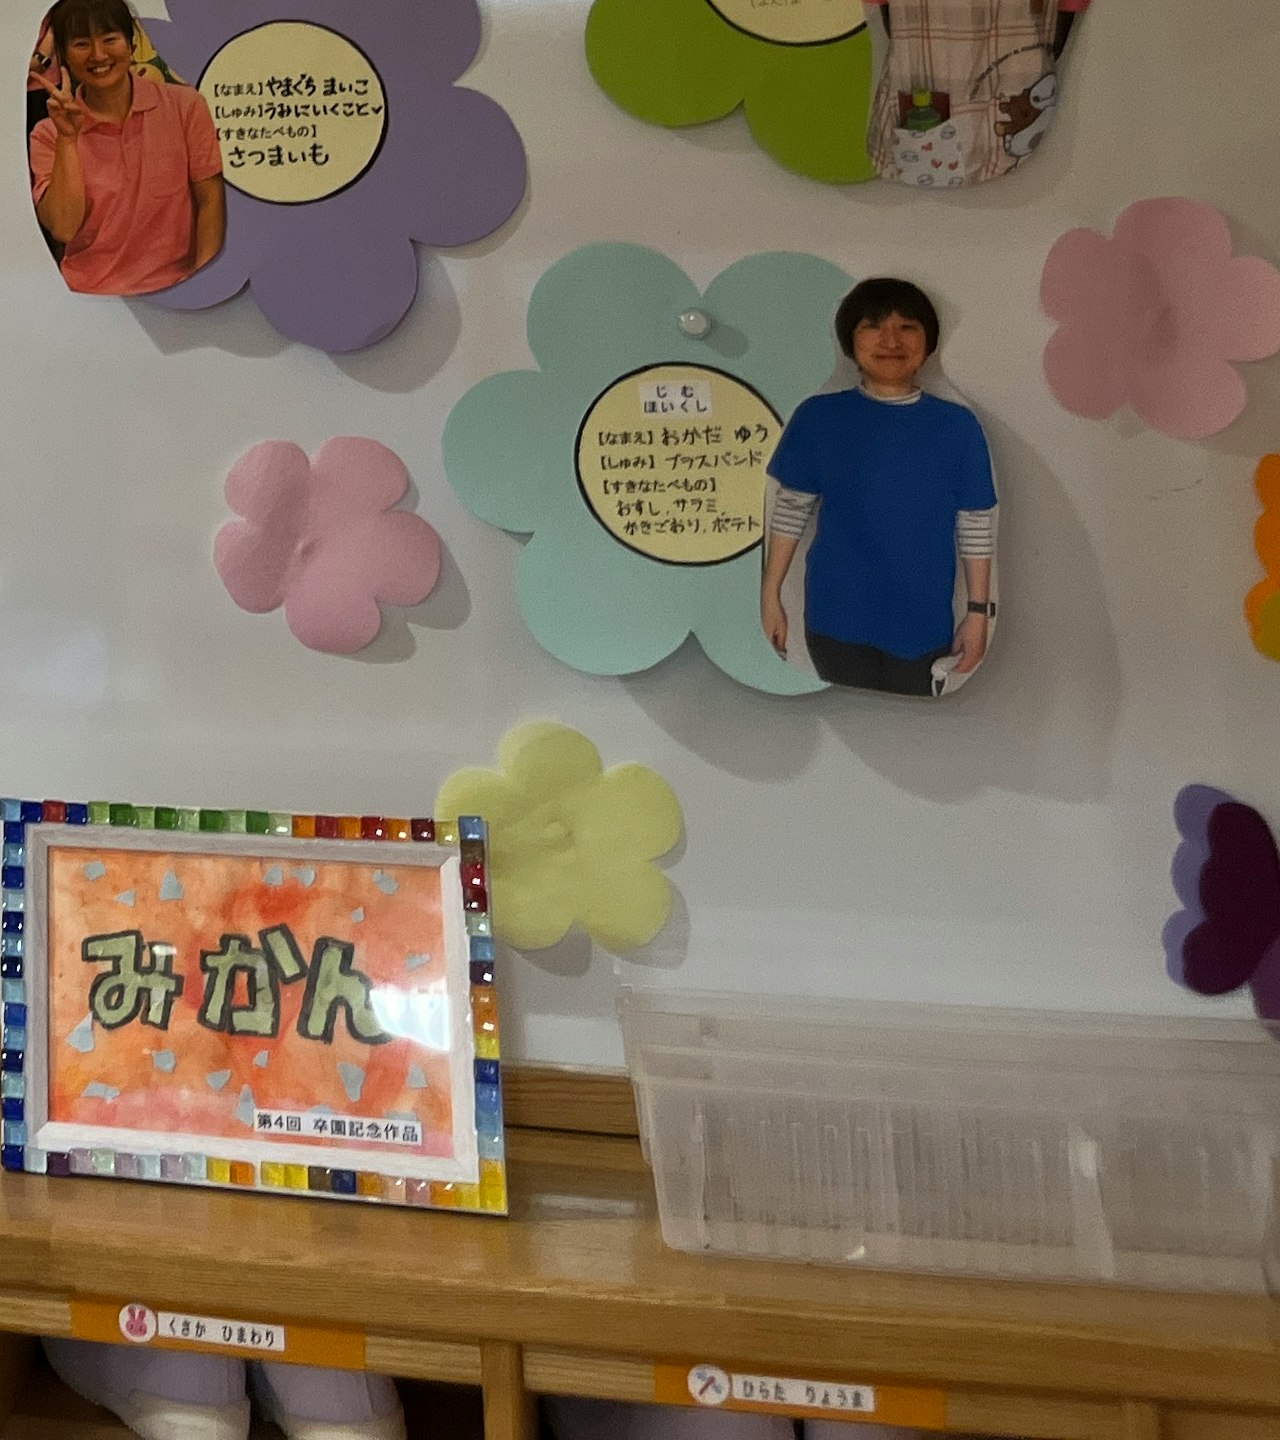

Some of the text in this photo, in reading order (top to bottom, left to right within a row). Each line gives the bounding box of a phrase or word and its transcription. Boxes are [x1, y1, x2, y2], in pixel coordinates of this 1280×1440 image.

[265, 73, 318, 98] やまぐち
[323, 77, 370, 97] まいこ
[228, 143, 330, 169] さつまいも
[656, 385, 695, 400] じむ
[644, 401, 709, 415] ほいくし
[661, 426, 723, 447] おかだ
[733, 423, 769, 445] ゆう
[664, 447, 763, 471] ブラスバンド
[602, 477, 718, 496] 【すきなたべもの】
[712, 513, 761, 535] ポテト
[81, 922, 392, 1047] みかん
[255, 1111, 421, 1143] 第4回 卒園記念作品
[169, 1316, 276, 1348] くさか ひまわり
[743, 1379, 865, 1409] ひらた りょうま
